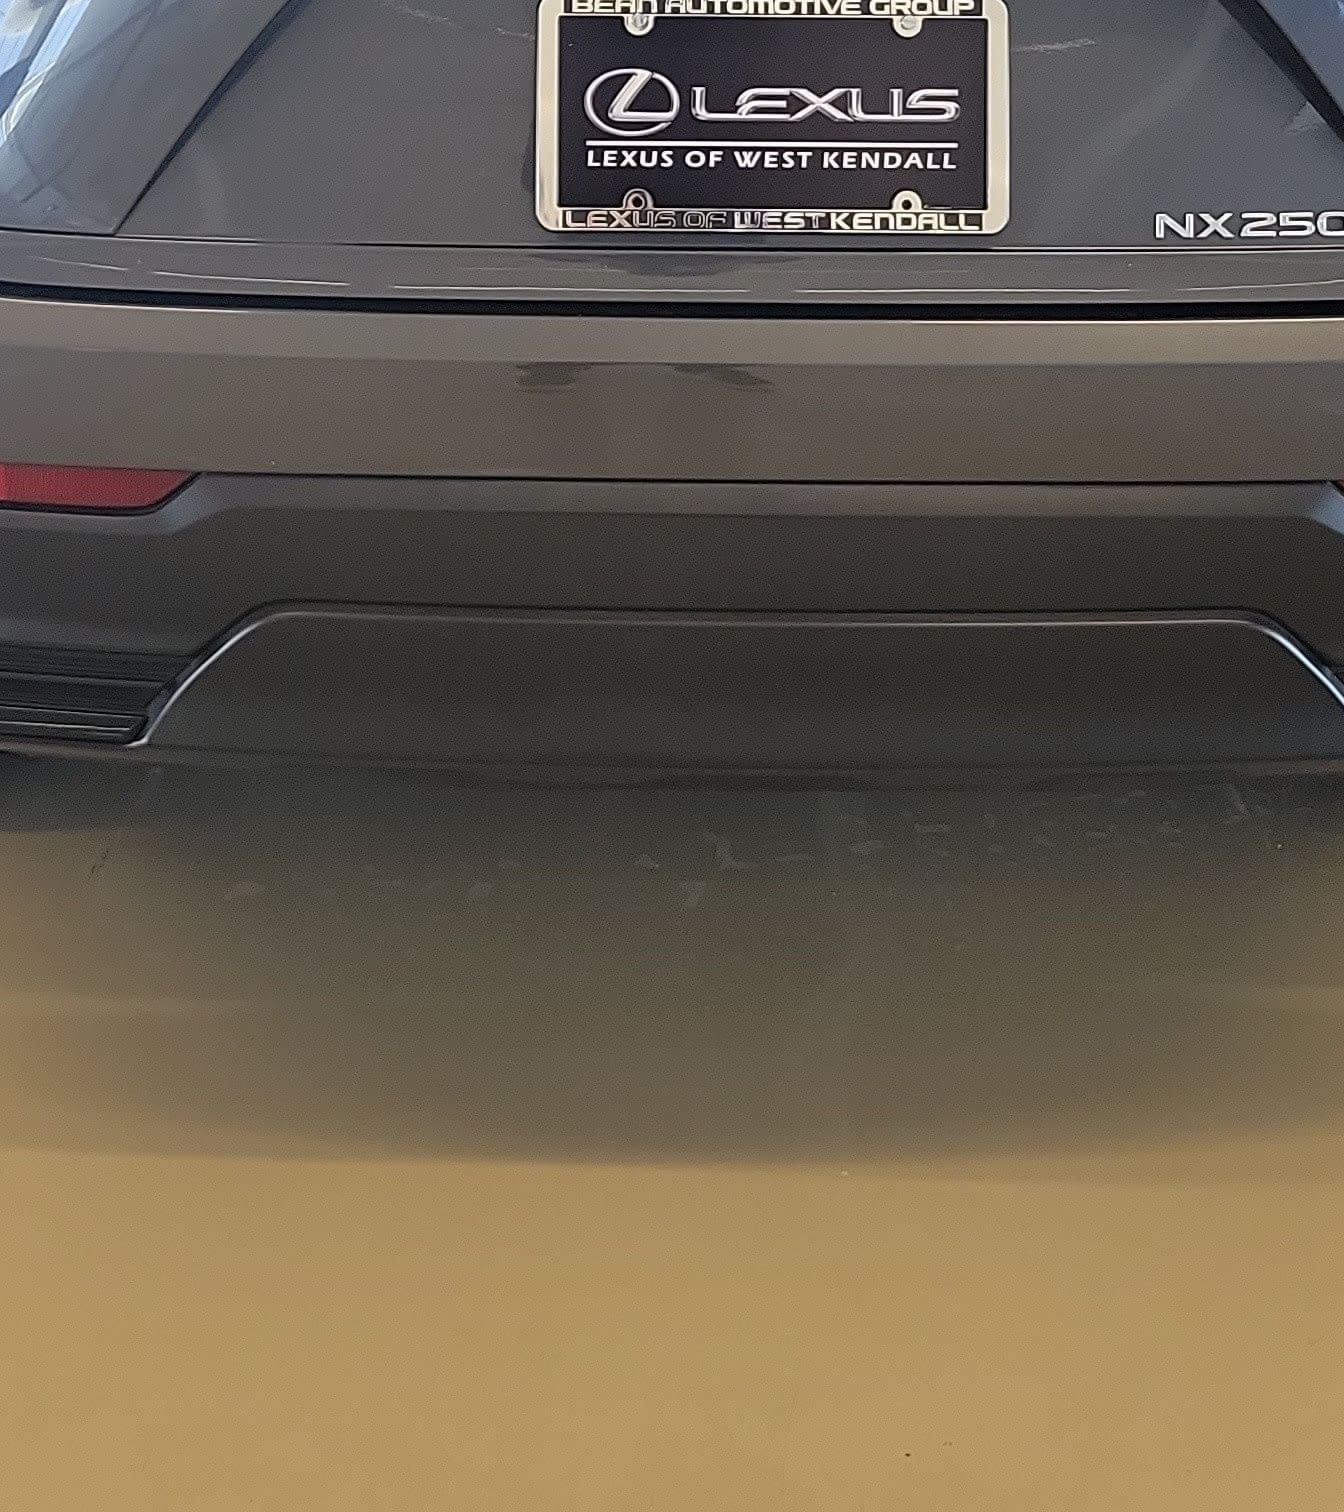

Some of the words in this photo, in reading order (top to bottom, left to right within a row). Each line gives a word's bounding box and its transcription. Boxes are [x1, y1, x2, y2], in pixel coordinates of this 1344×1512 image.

[692, 86, 961, 122] LEXUS
[586, 149, 674, 168] LEXUS
[684, 150, 724, 168] OF
[734, 150, 813, 169] WEST
[822, 151, 957, 170] KENDALL
[565, 209, 677, 229] LEXUS
[682, 210, 727, 229] OF
[733, 211, 826, 230] WEST
[829, 212, 981, 232] KENDALL
